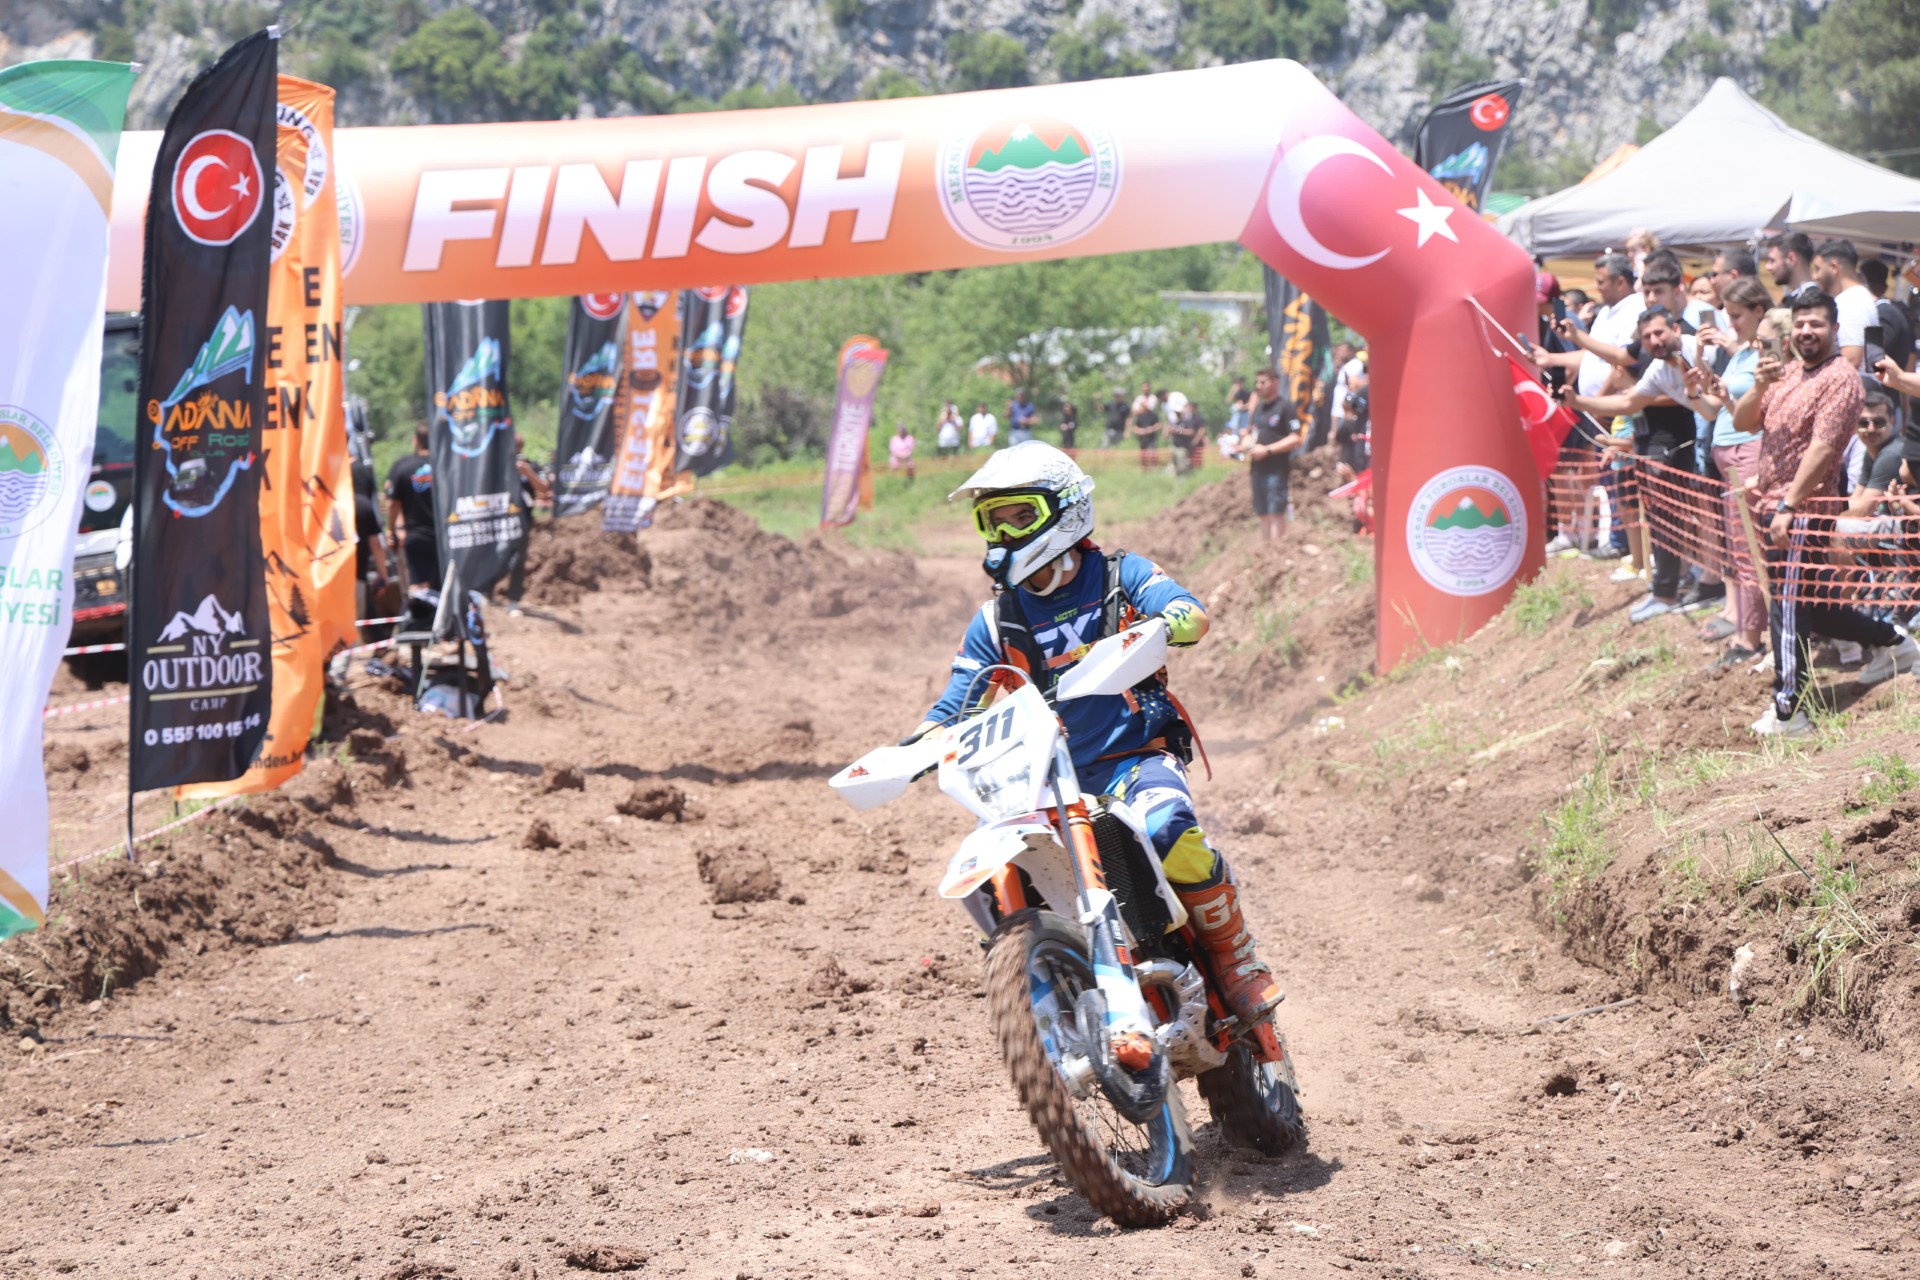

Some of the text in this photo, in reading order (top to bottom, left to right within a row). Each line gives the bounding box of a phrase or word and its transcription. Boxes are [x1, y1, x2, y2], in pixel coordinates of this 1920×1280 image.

[402, 139, 905, 272] FINISH
[165, 398, 251, 432] ADANA
[0, 566, 63, 591] SLAR
[0, 598, 61, 626] YESİ
[192, 631, 226, 656] NY
[143, 652, 264, 691] OUTDOOR
[190, 697, 228, 711] CAMP
[144, 728, 158, 746] 0
[196, 721, 223, 740] 100
[225, 720, 242, 737] 15
[957, 706, 1015, 766] 311
